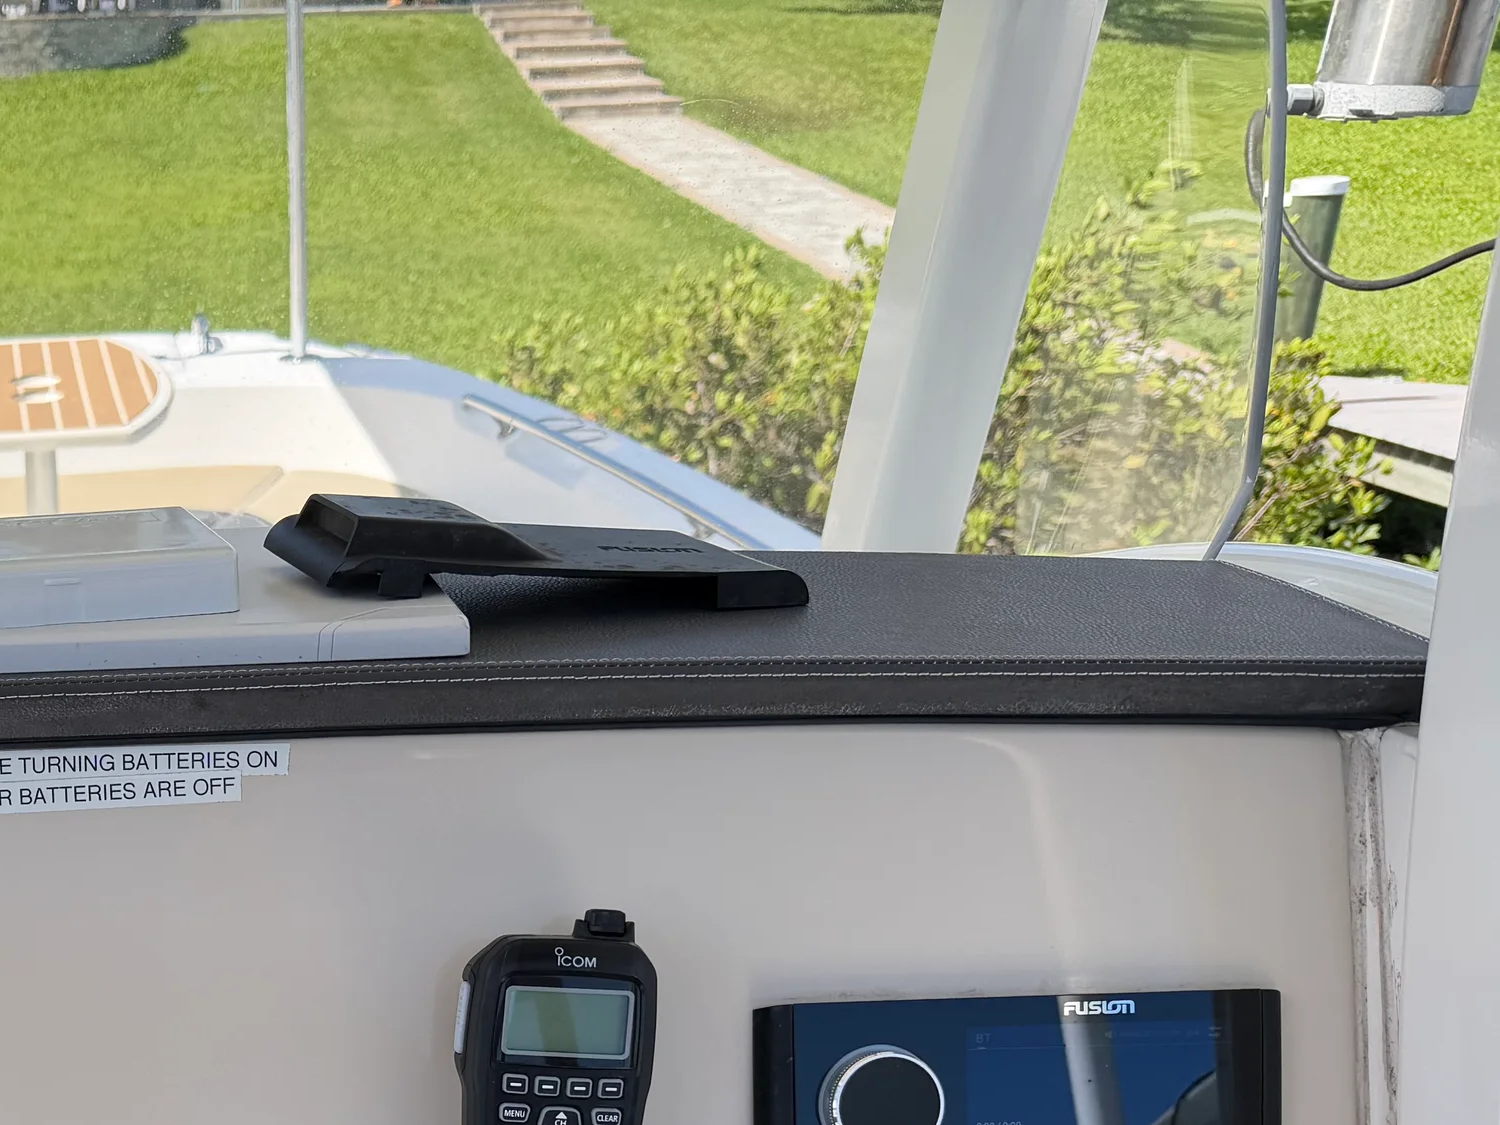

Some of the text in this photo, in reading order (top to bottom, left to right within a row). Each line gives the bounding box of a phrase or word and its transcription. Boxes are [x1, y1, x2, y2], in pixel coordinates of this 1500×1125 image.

[18, 754, 115, 774] TURNING
[122, 751, 240, 770] BATTERIES
[247, 750, 278, 768] ON
[20, 782, 136, 805] BATTERIES
[144, 780, 186, 798] ARE
[193, 777, 235, 796] OFF
[1063, 1000, 1136, 1016] FUSION
[976, 1033, 991, 1044] BT
[504, 1108, 526, 1119] MENU
[597, 1113, 618, 1124] CLEAR
